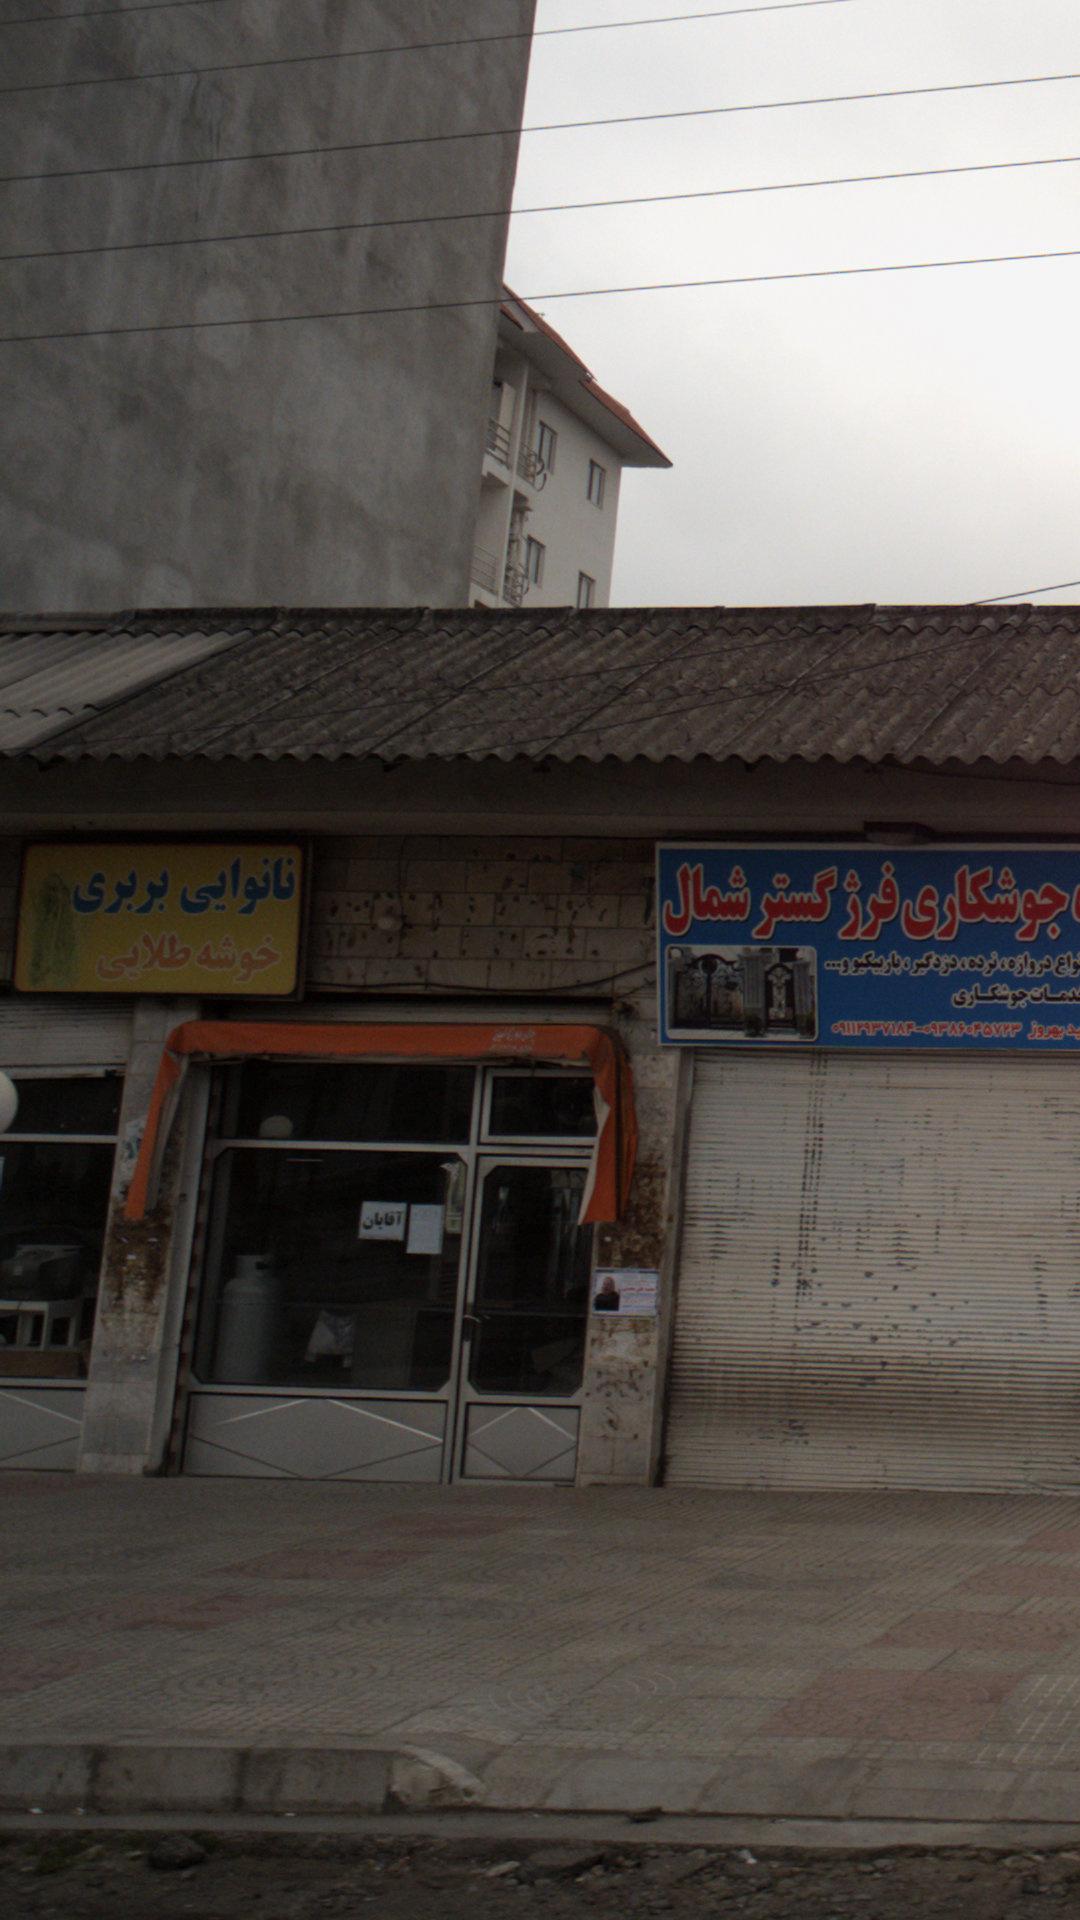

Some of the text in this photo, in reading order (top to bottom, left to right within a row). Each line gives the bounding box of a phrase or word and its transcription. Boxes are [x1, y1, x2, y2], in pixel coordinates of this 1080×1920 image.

[72, 857, 296, 915] نانوایی بربری
[663, 862, 751, 935] شمال
[752, 866, 838, 939] گستر
[902, 862, 1070, 941] جوشکاری
[95, 932, 281, 983] خوشه طلایی
[1052, 951, 1080, 977] واع
[951, 983, 1080, 1009] دمات جوشکاری
